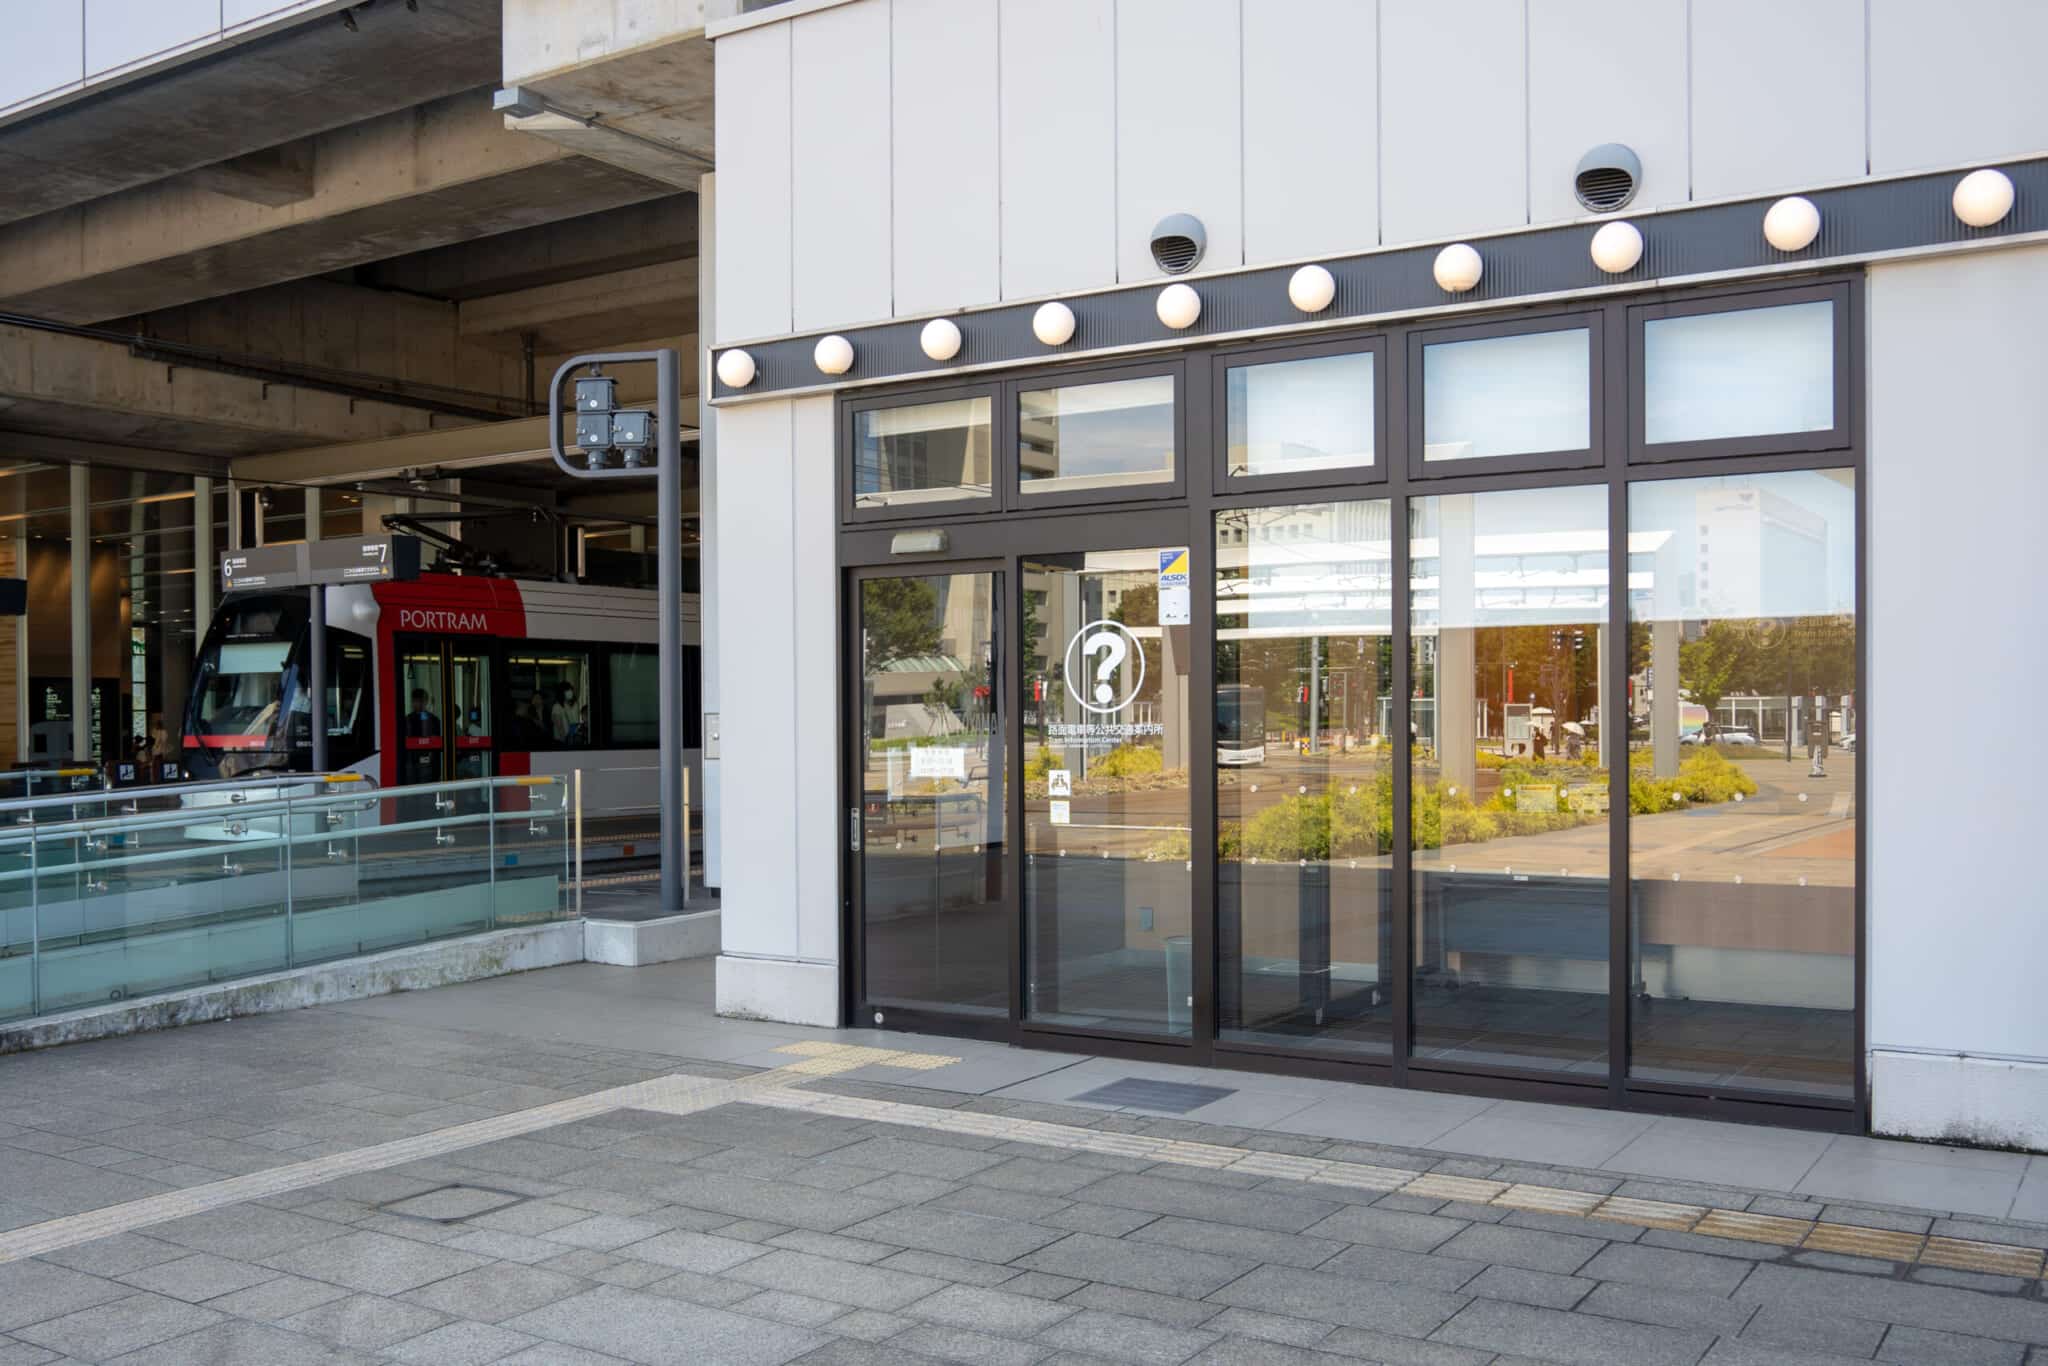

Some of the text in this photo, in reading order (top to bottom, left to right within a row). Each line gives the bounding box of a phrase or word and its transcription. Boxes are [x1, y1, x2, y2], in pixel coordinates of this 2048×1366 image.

[378, 544, 387, 563] 7
[224, 558, 233, 576] 6
[1161, 574, 1187, 582] ALSOK
[400, 608, 488, 631] PORTRAM
